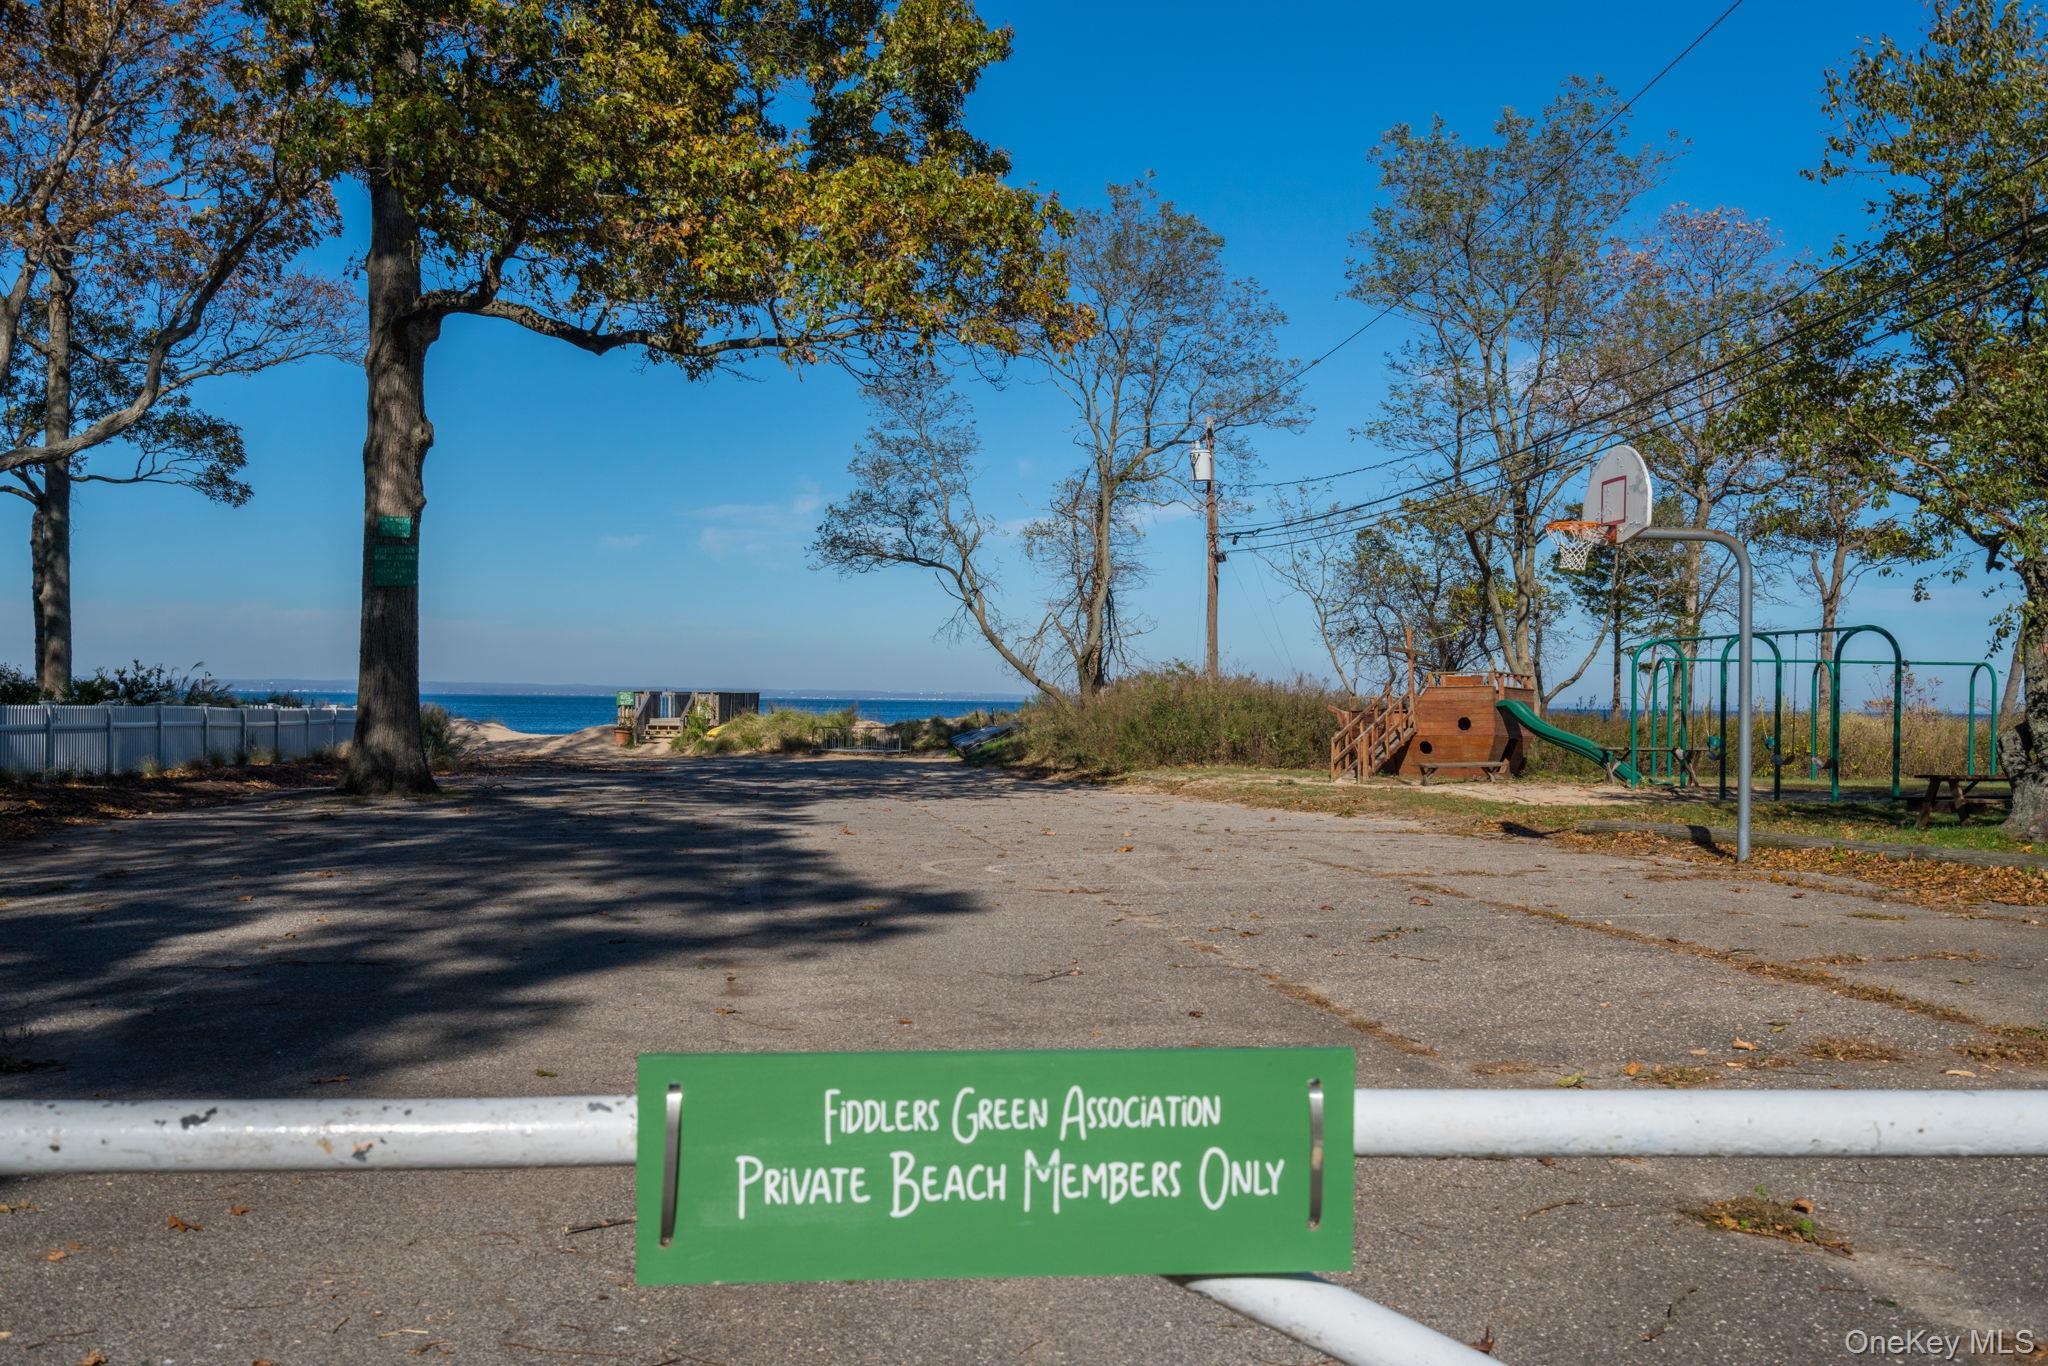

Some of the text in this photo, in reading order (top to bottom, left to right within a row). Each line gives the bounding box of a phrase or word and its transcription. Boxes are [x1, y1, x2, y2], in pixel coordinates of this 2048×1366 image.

[951, 1086, 1048, 1145] GREEN
[889, 1150, 1007, 1218] BEACH
[1023, 1147, 1182, 1215] MEMBERS
[1199, 1146, 1285, 1211] ONLY
